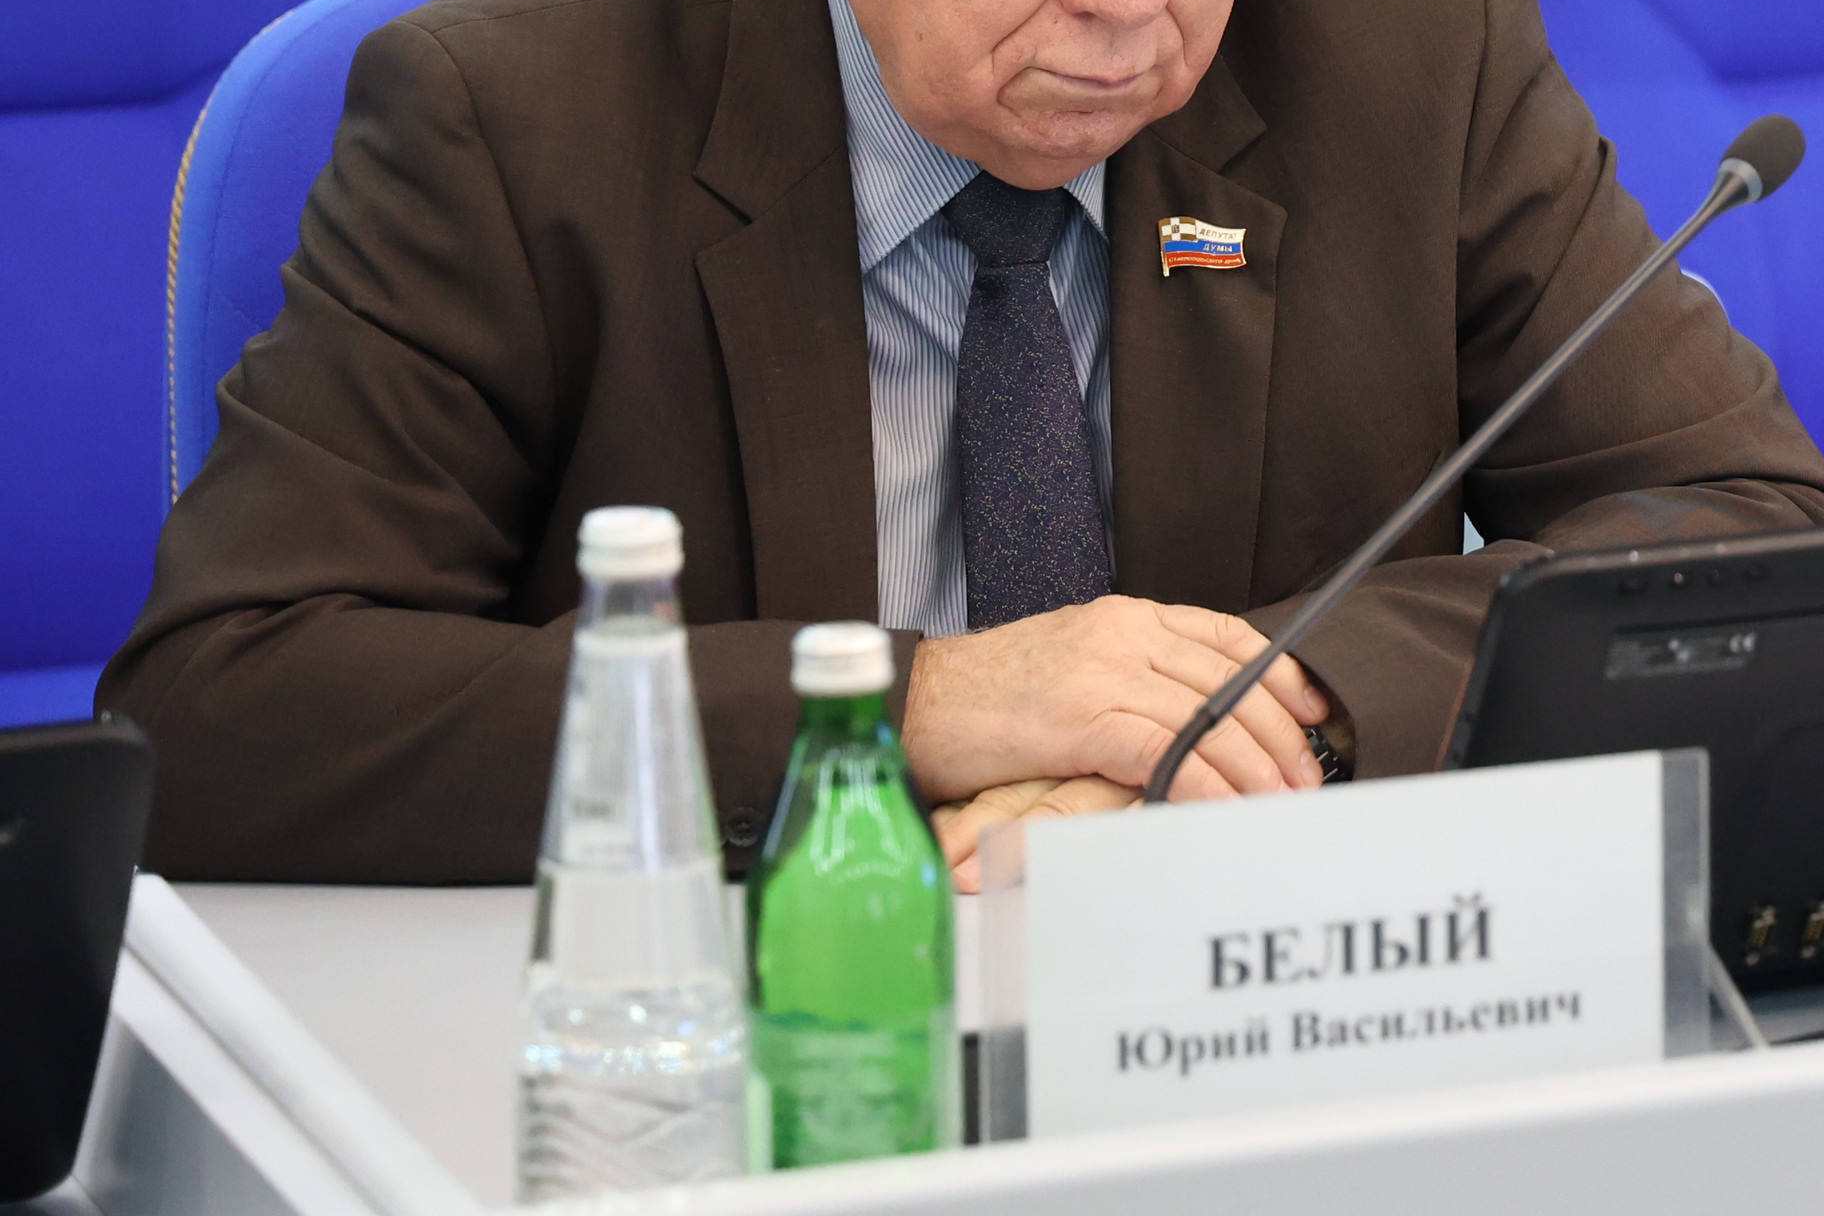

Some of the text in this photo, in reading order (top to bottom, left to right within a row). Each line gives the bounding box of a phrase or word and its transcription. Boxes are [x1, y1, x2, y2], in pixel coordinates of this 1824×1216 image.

[1202, 243, 1233, 253] ДУМЫ
[1207, 891, 1495, 991] БЕЛЫЙ
[1115, 990, 1584, 1077] Юрий Васильевич
